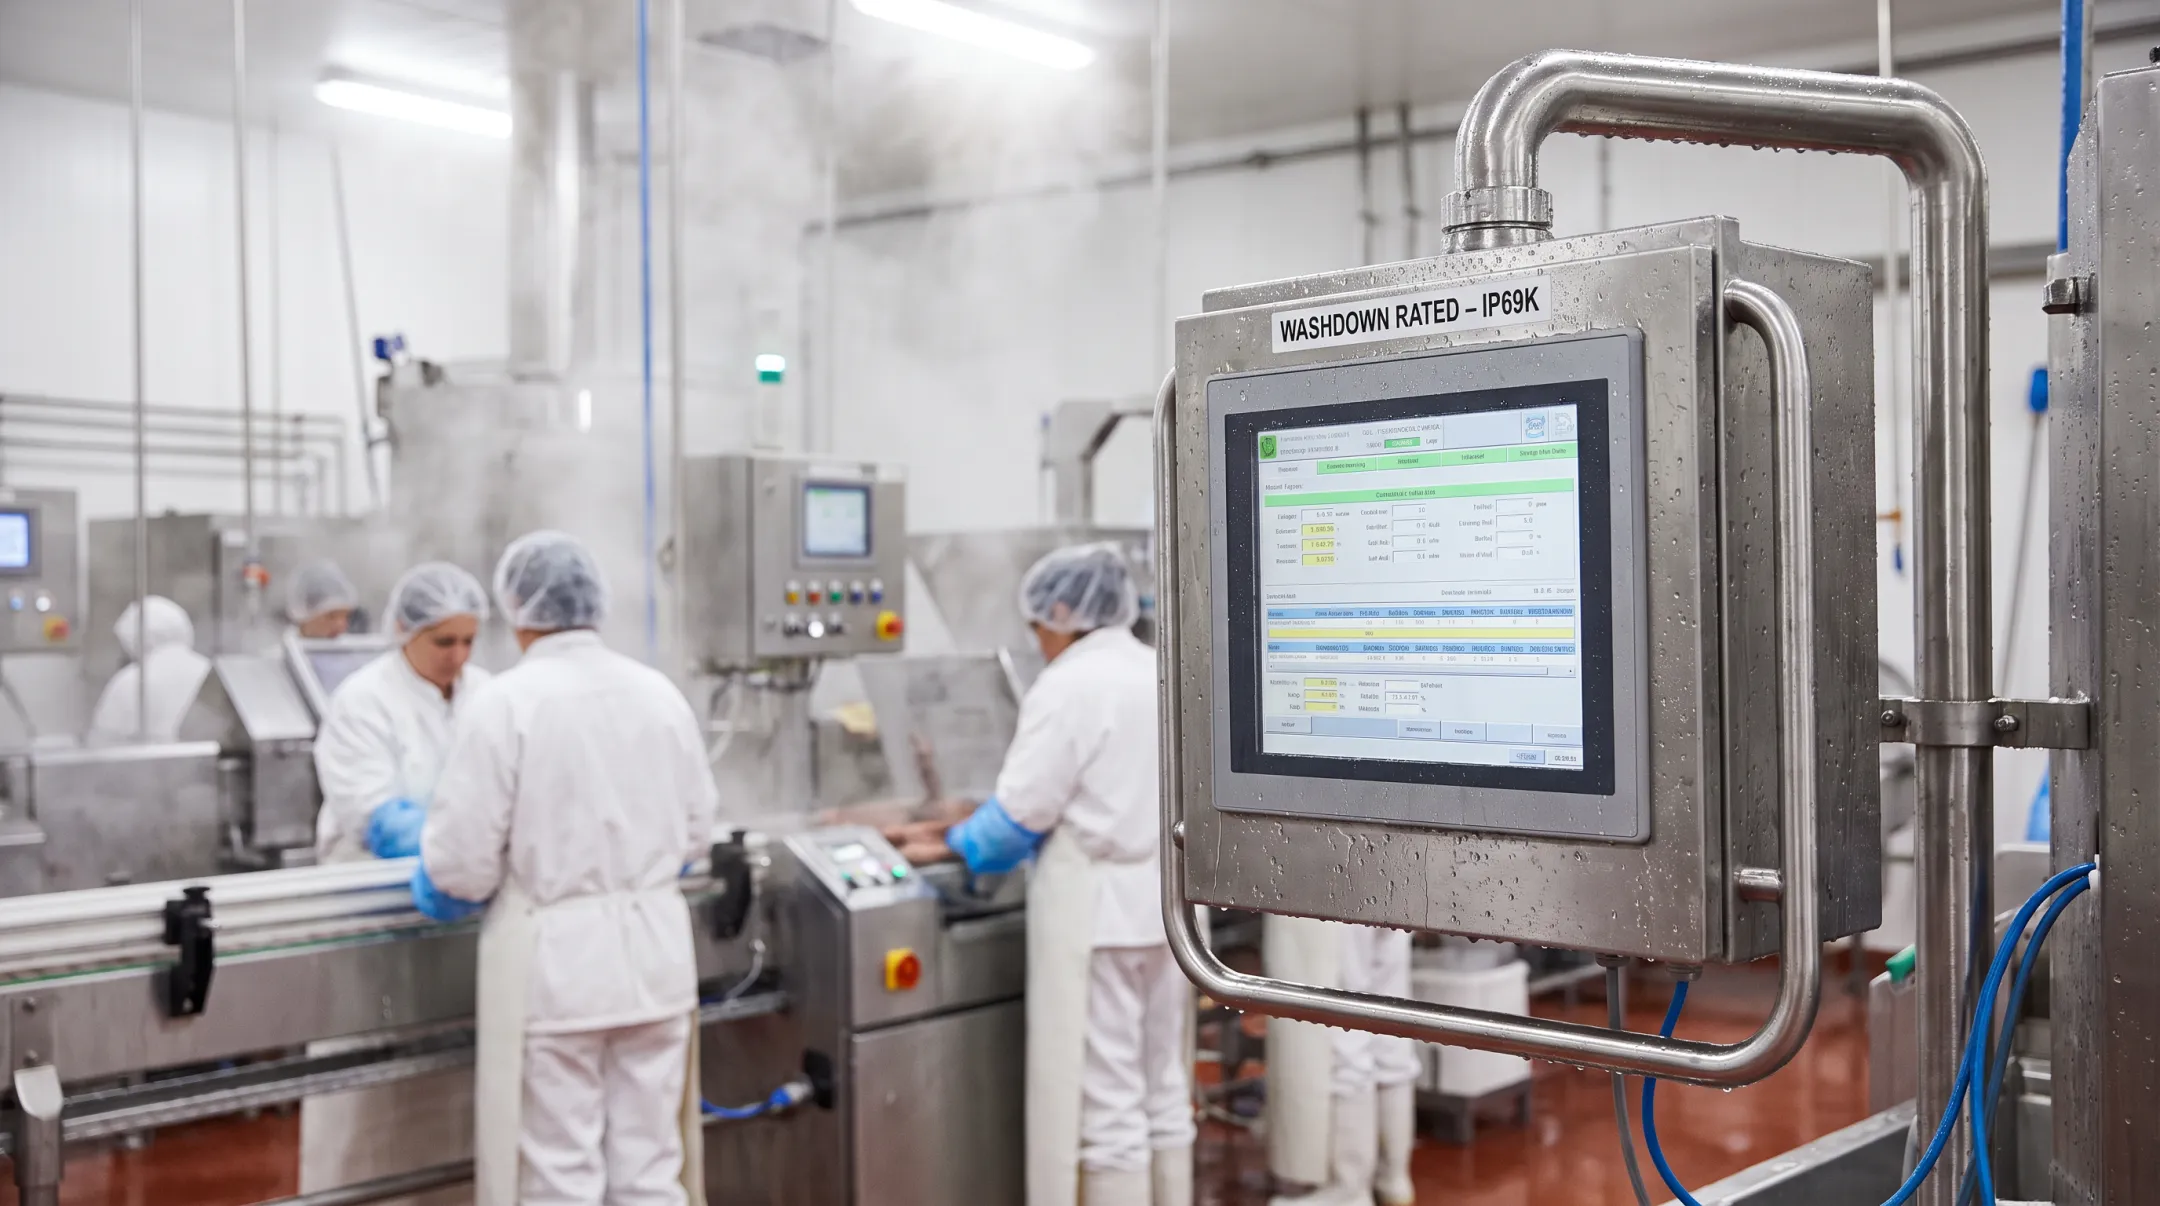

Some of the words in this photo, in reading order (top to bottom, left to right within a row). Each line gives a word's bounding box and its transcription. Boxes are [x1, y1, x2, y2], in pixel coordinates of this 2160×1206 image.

[1280, 307, 1389, 342] WASHDOWN
[1396, 298, 1459, 329] RATED
[1482, 286, 1540, 318] IP69K
